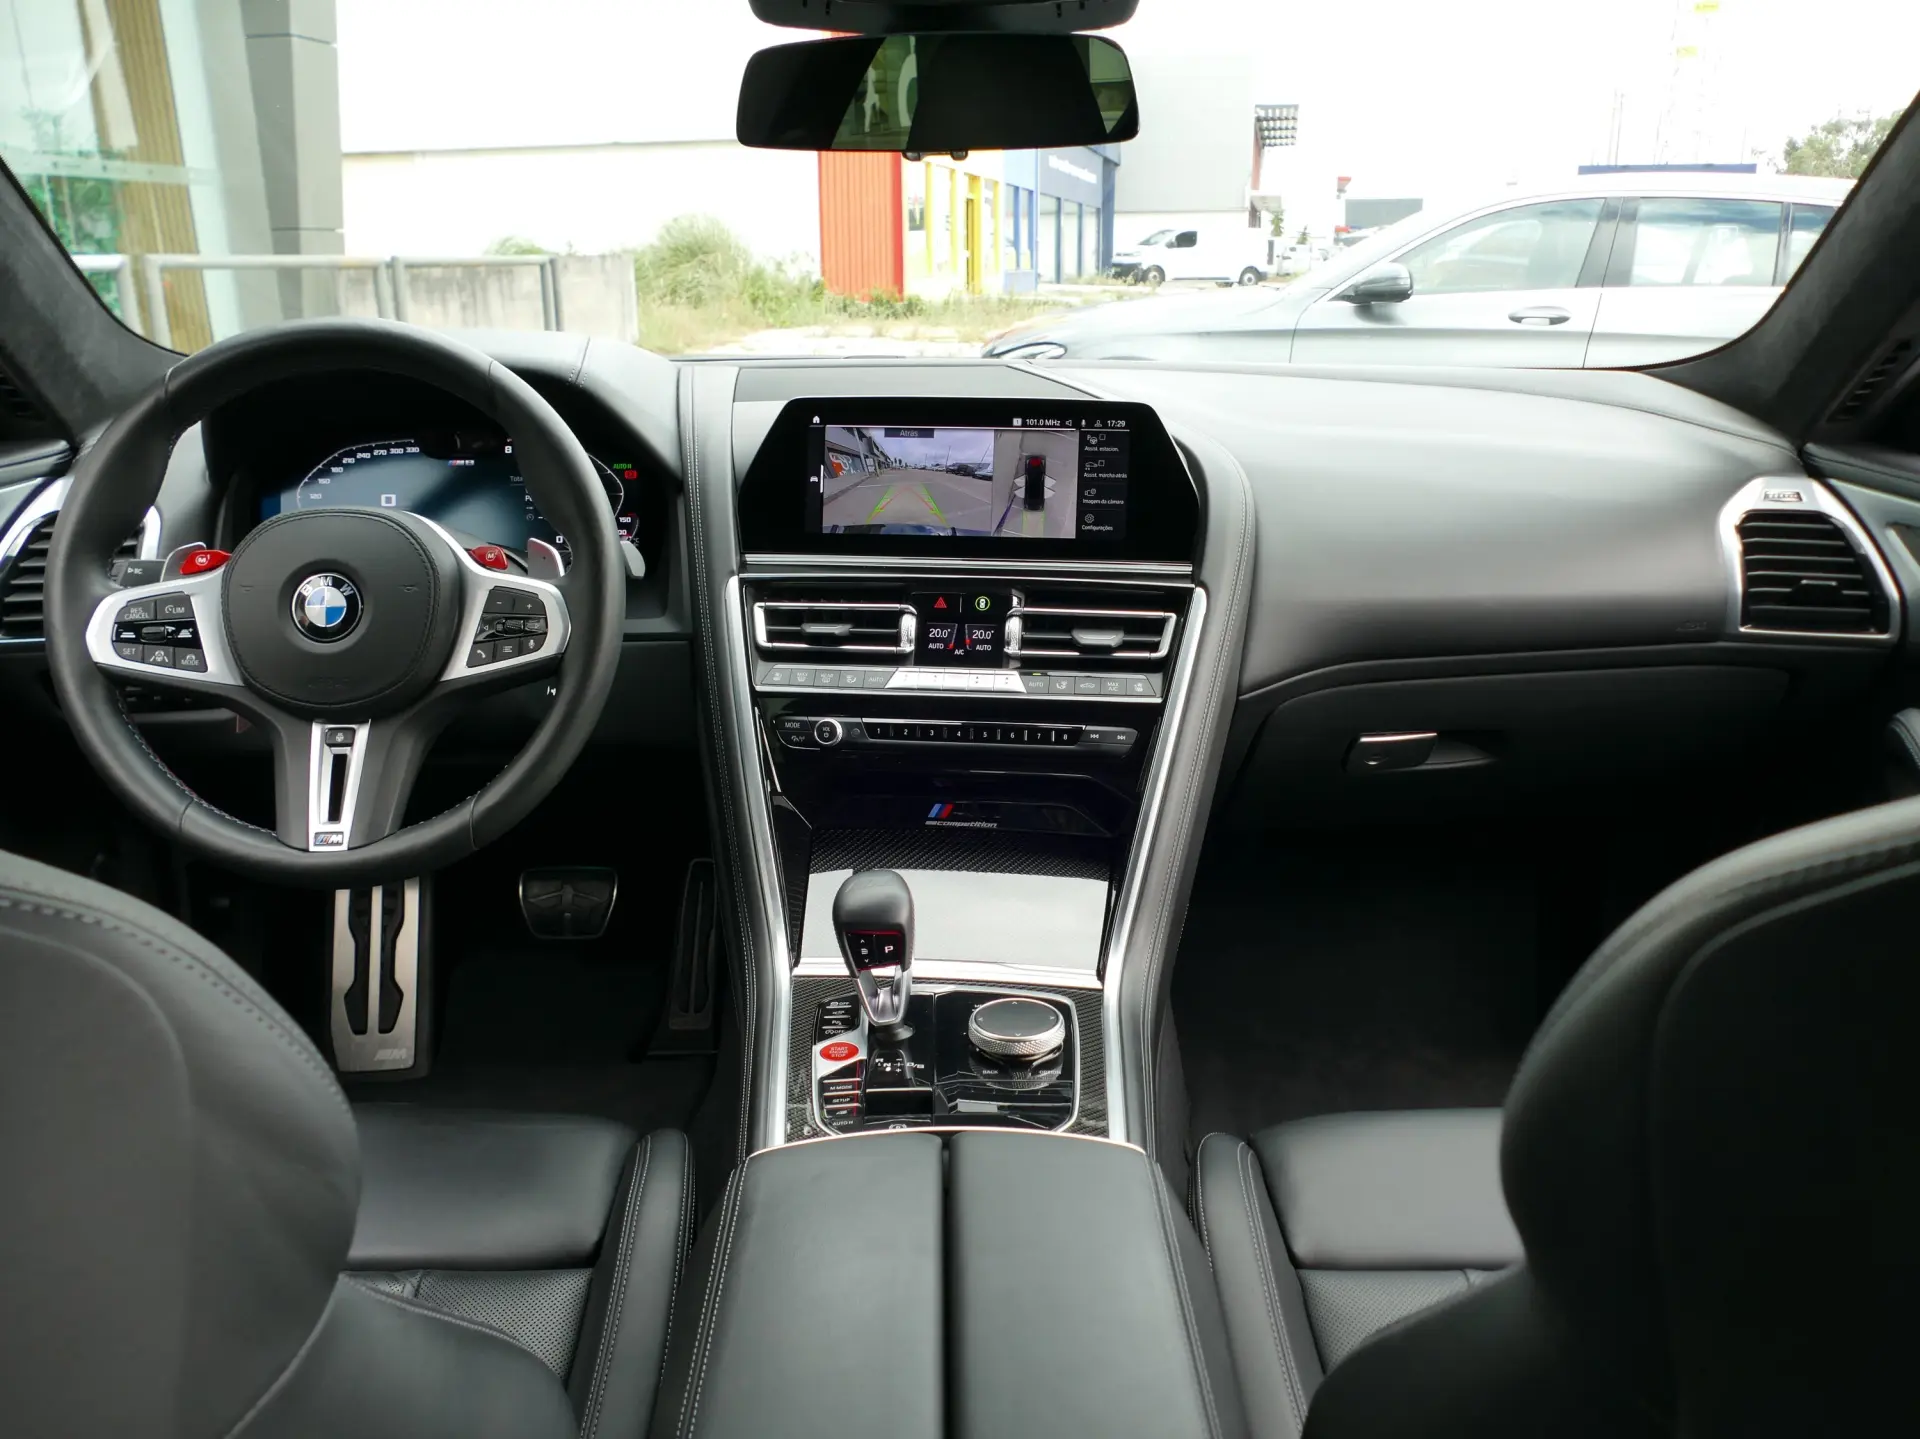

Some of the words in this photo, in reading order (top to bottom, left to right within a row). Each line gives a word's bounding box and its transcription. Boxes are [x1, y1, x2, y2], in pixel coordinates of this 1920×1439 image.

[1045, 419, 1061, 427] MHz
[300, 576, 355, 597] BMW
[172, 606, 186, 614] LIM
[124, 612, 150, 620] CANCEL
[784, 721, 801, 729] MODE
[884, 945, 894, 953] P
